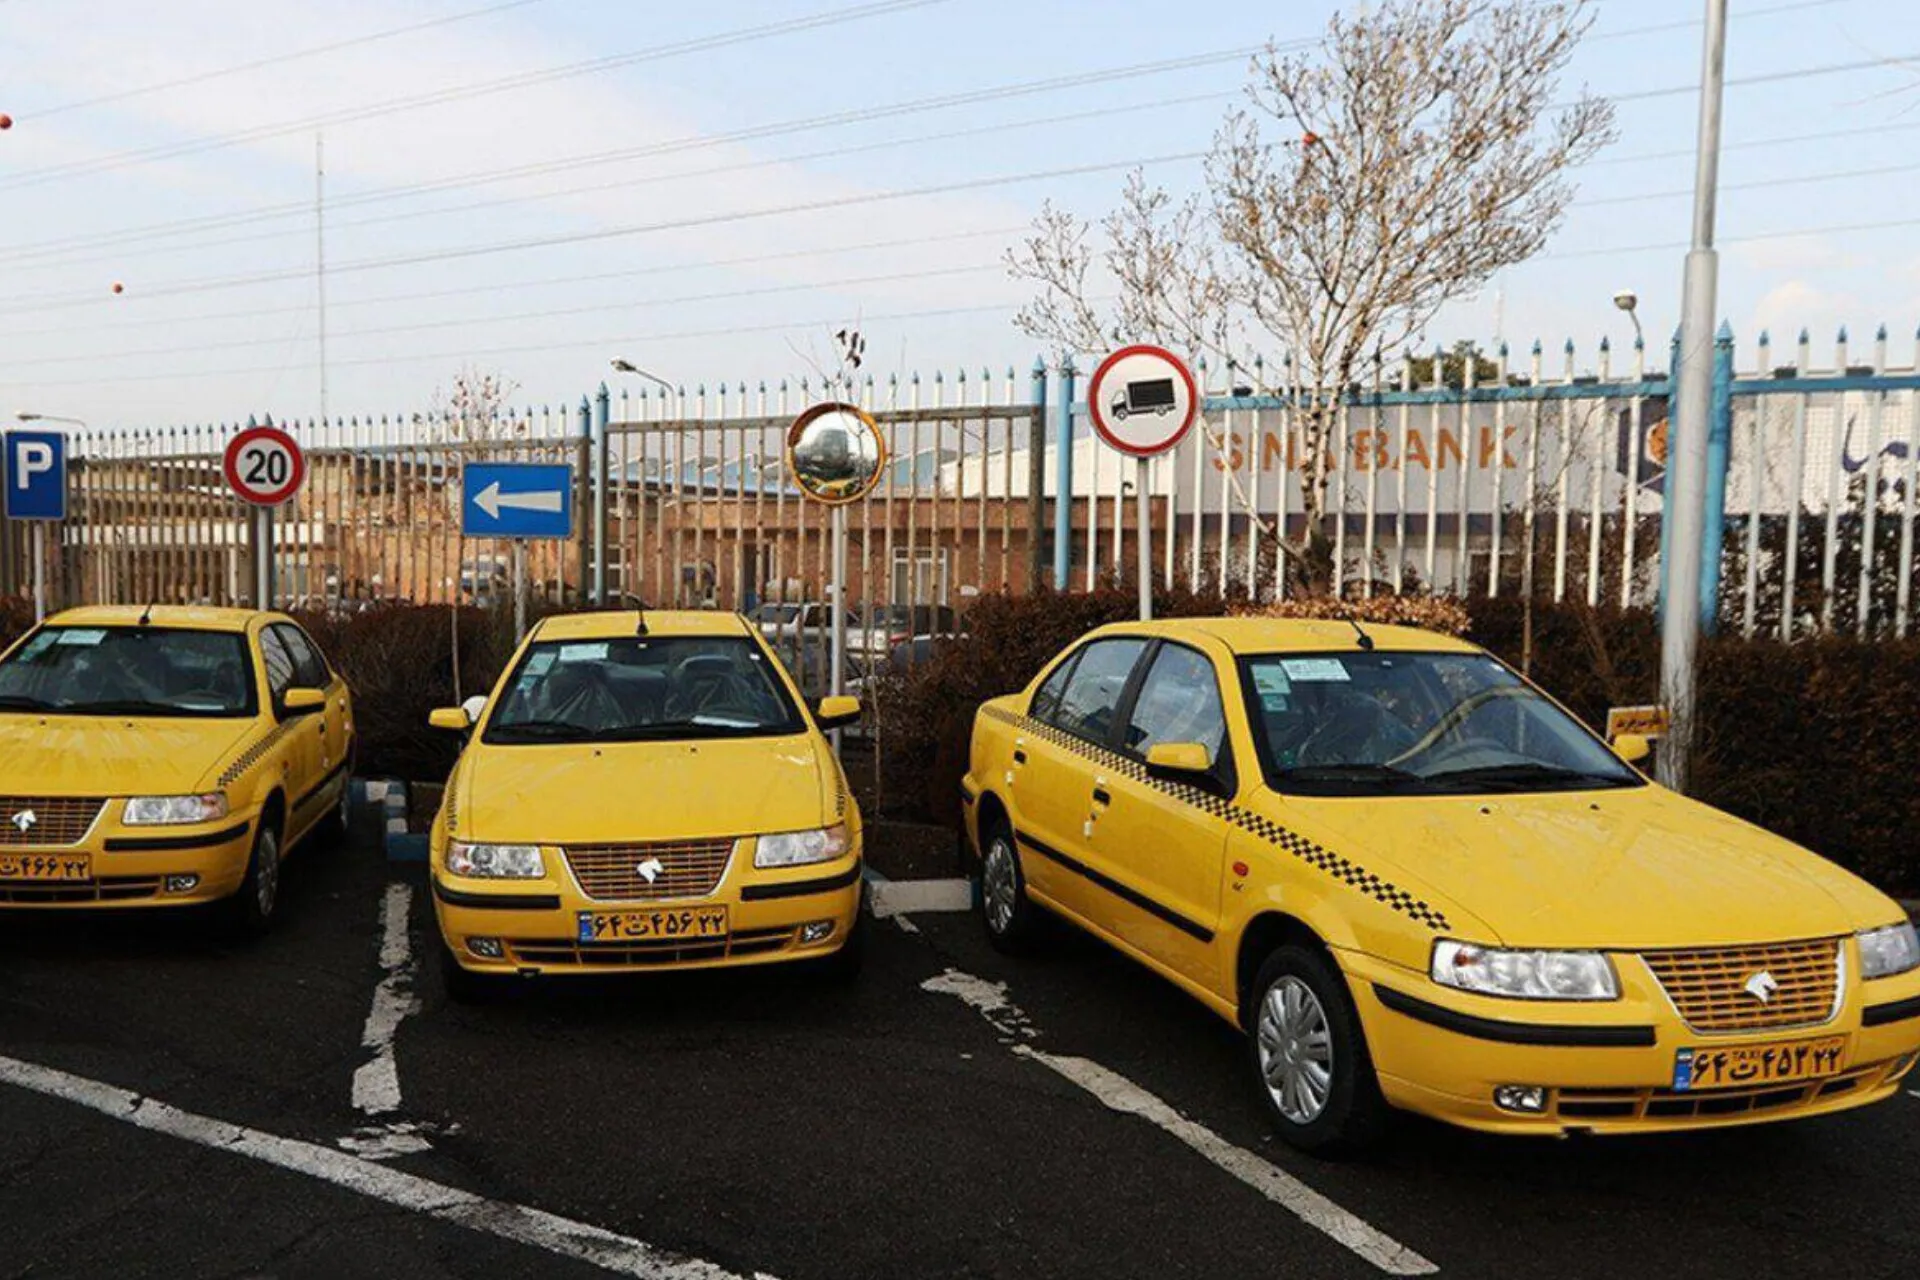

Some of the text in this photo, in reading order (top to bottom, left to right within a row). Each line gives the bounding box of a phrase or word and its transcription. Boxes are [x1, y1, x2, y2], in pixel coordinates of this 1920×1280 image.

[17, 441, 53, 489] P
[245, 449, 287, 485] 20
[1354, 424, 1518, 472] BANK
